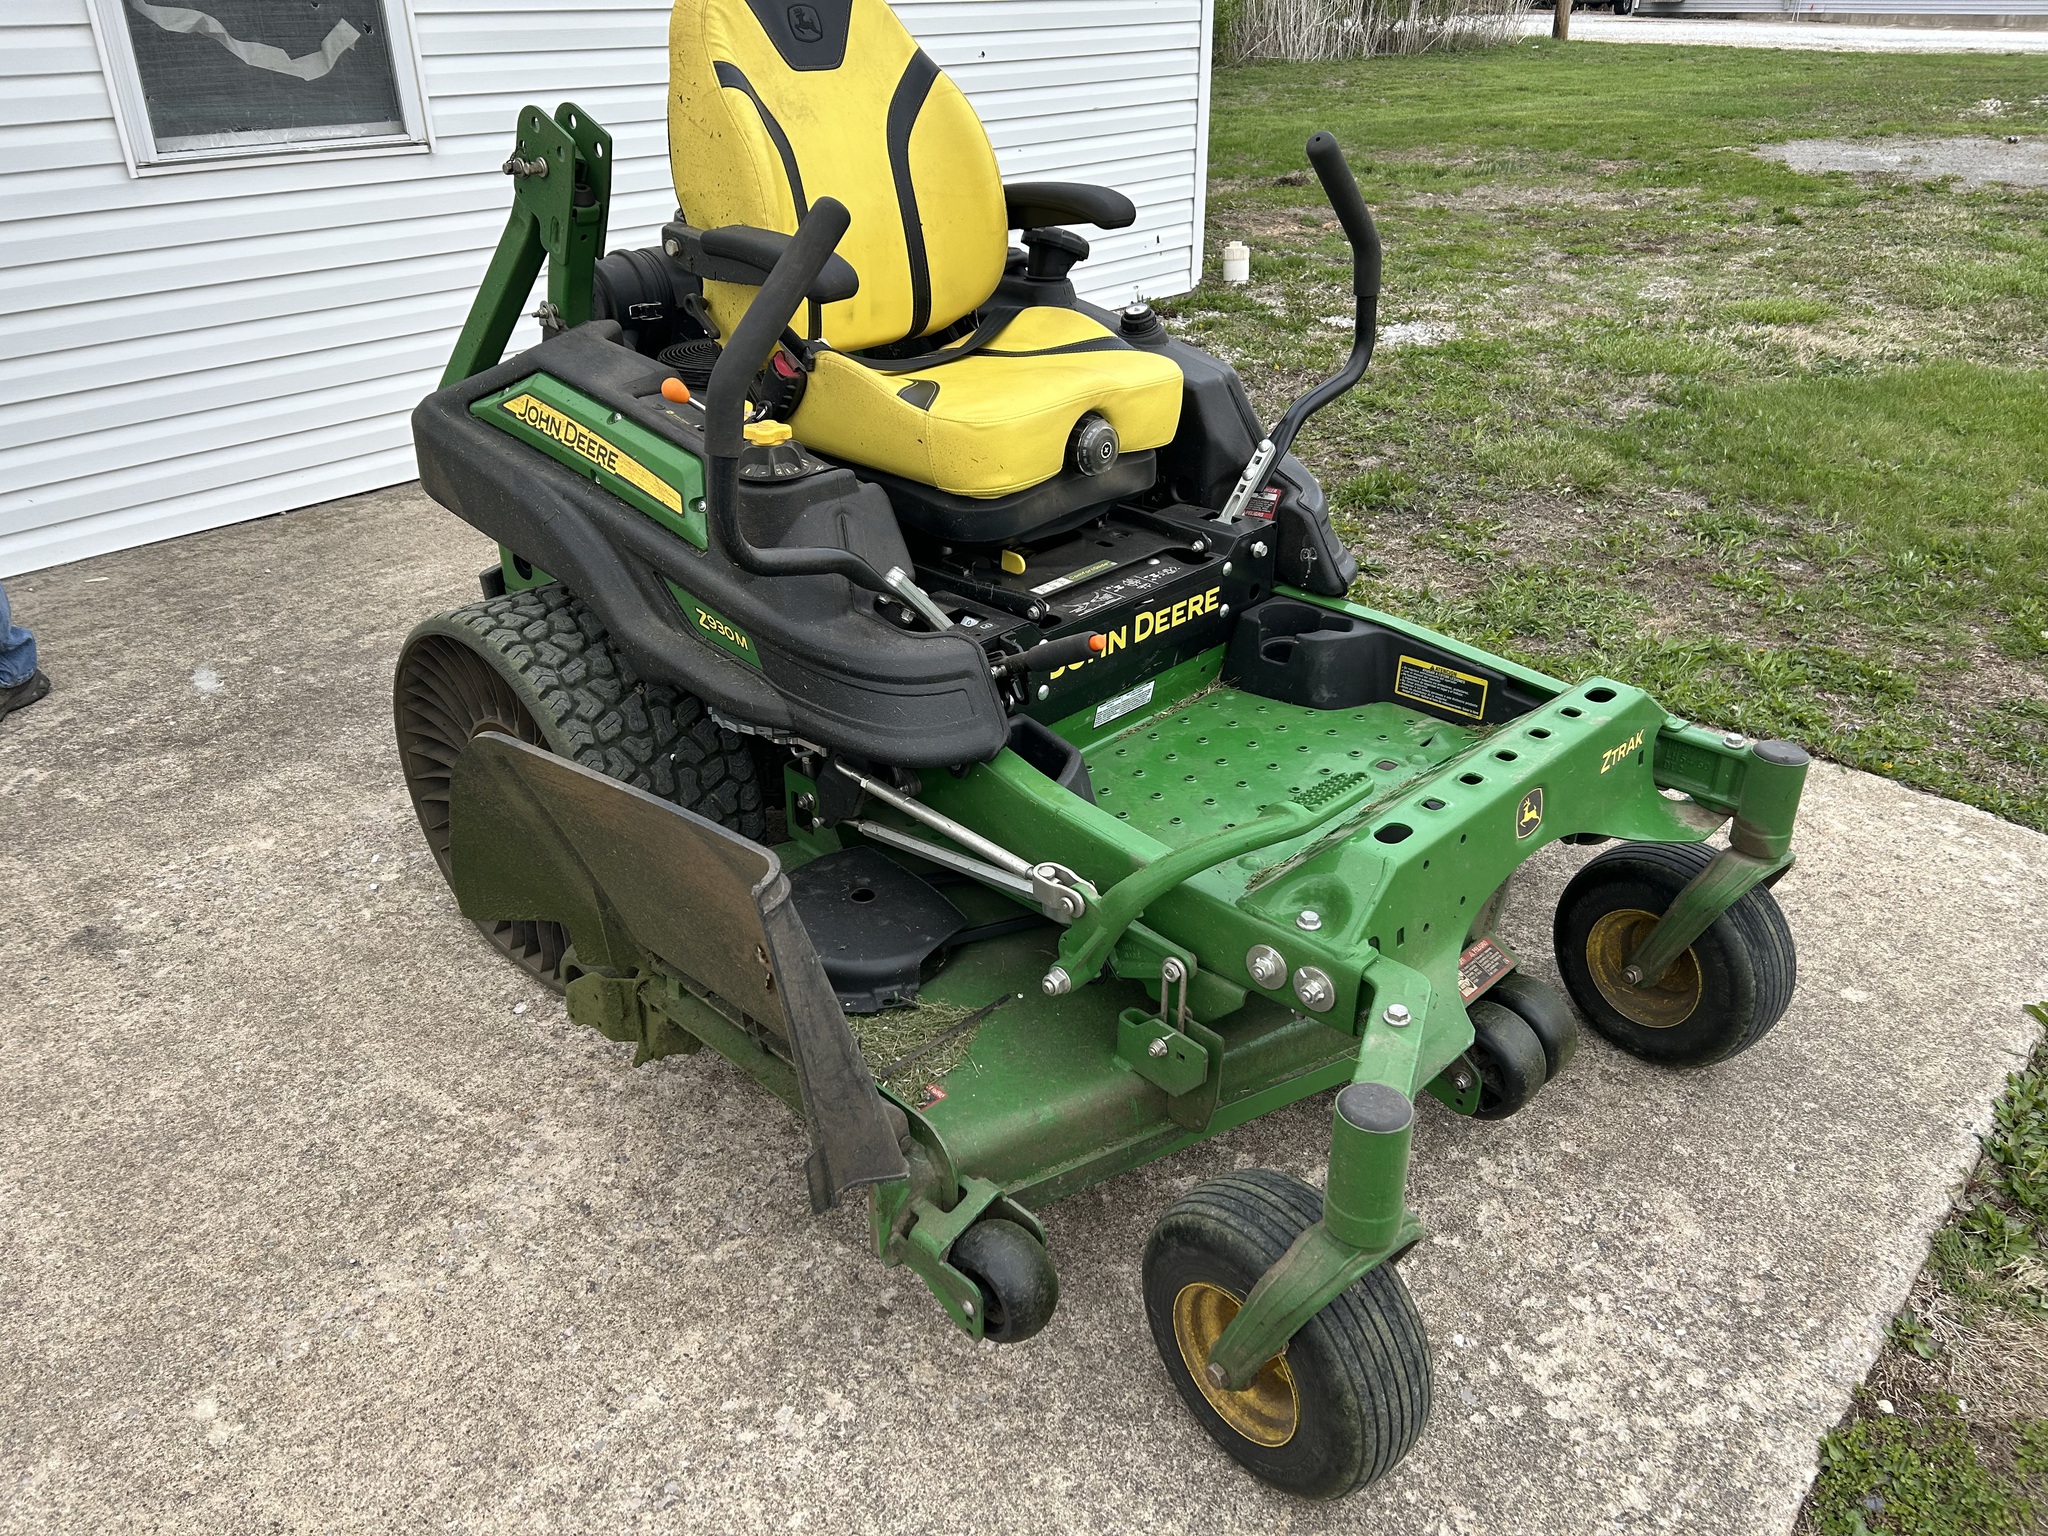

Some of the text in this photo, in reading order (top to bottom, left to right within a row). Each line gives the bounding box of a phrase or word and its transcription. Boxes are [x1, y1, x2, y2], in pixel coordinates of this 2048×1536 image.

[518, 399, 619, 472] JOHN DEERE
[695, 607, 749, 651] Z930M
[1134, 585, 1220, 643] DEERE
[1600, 728, 1644, 775] ZTRAK
